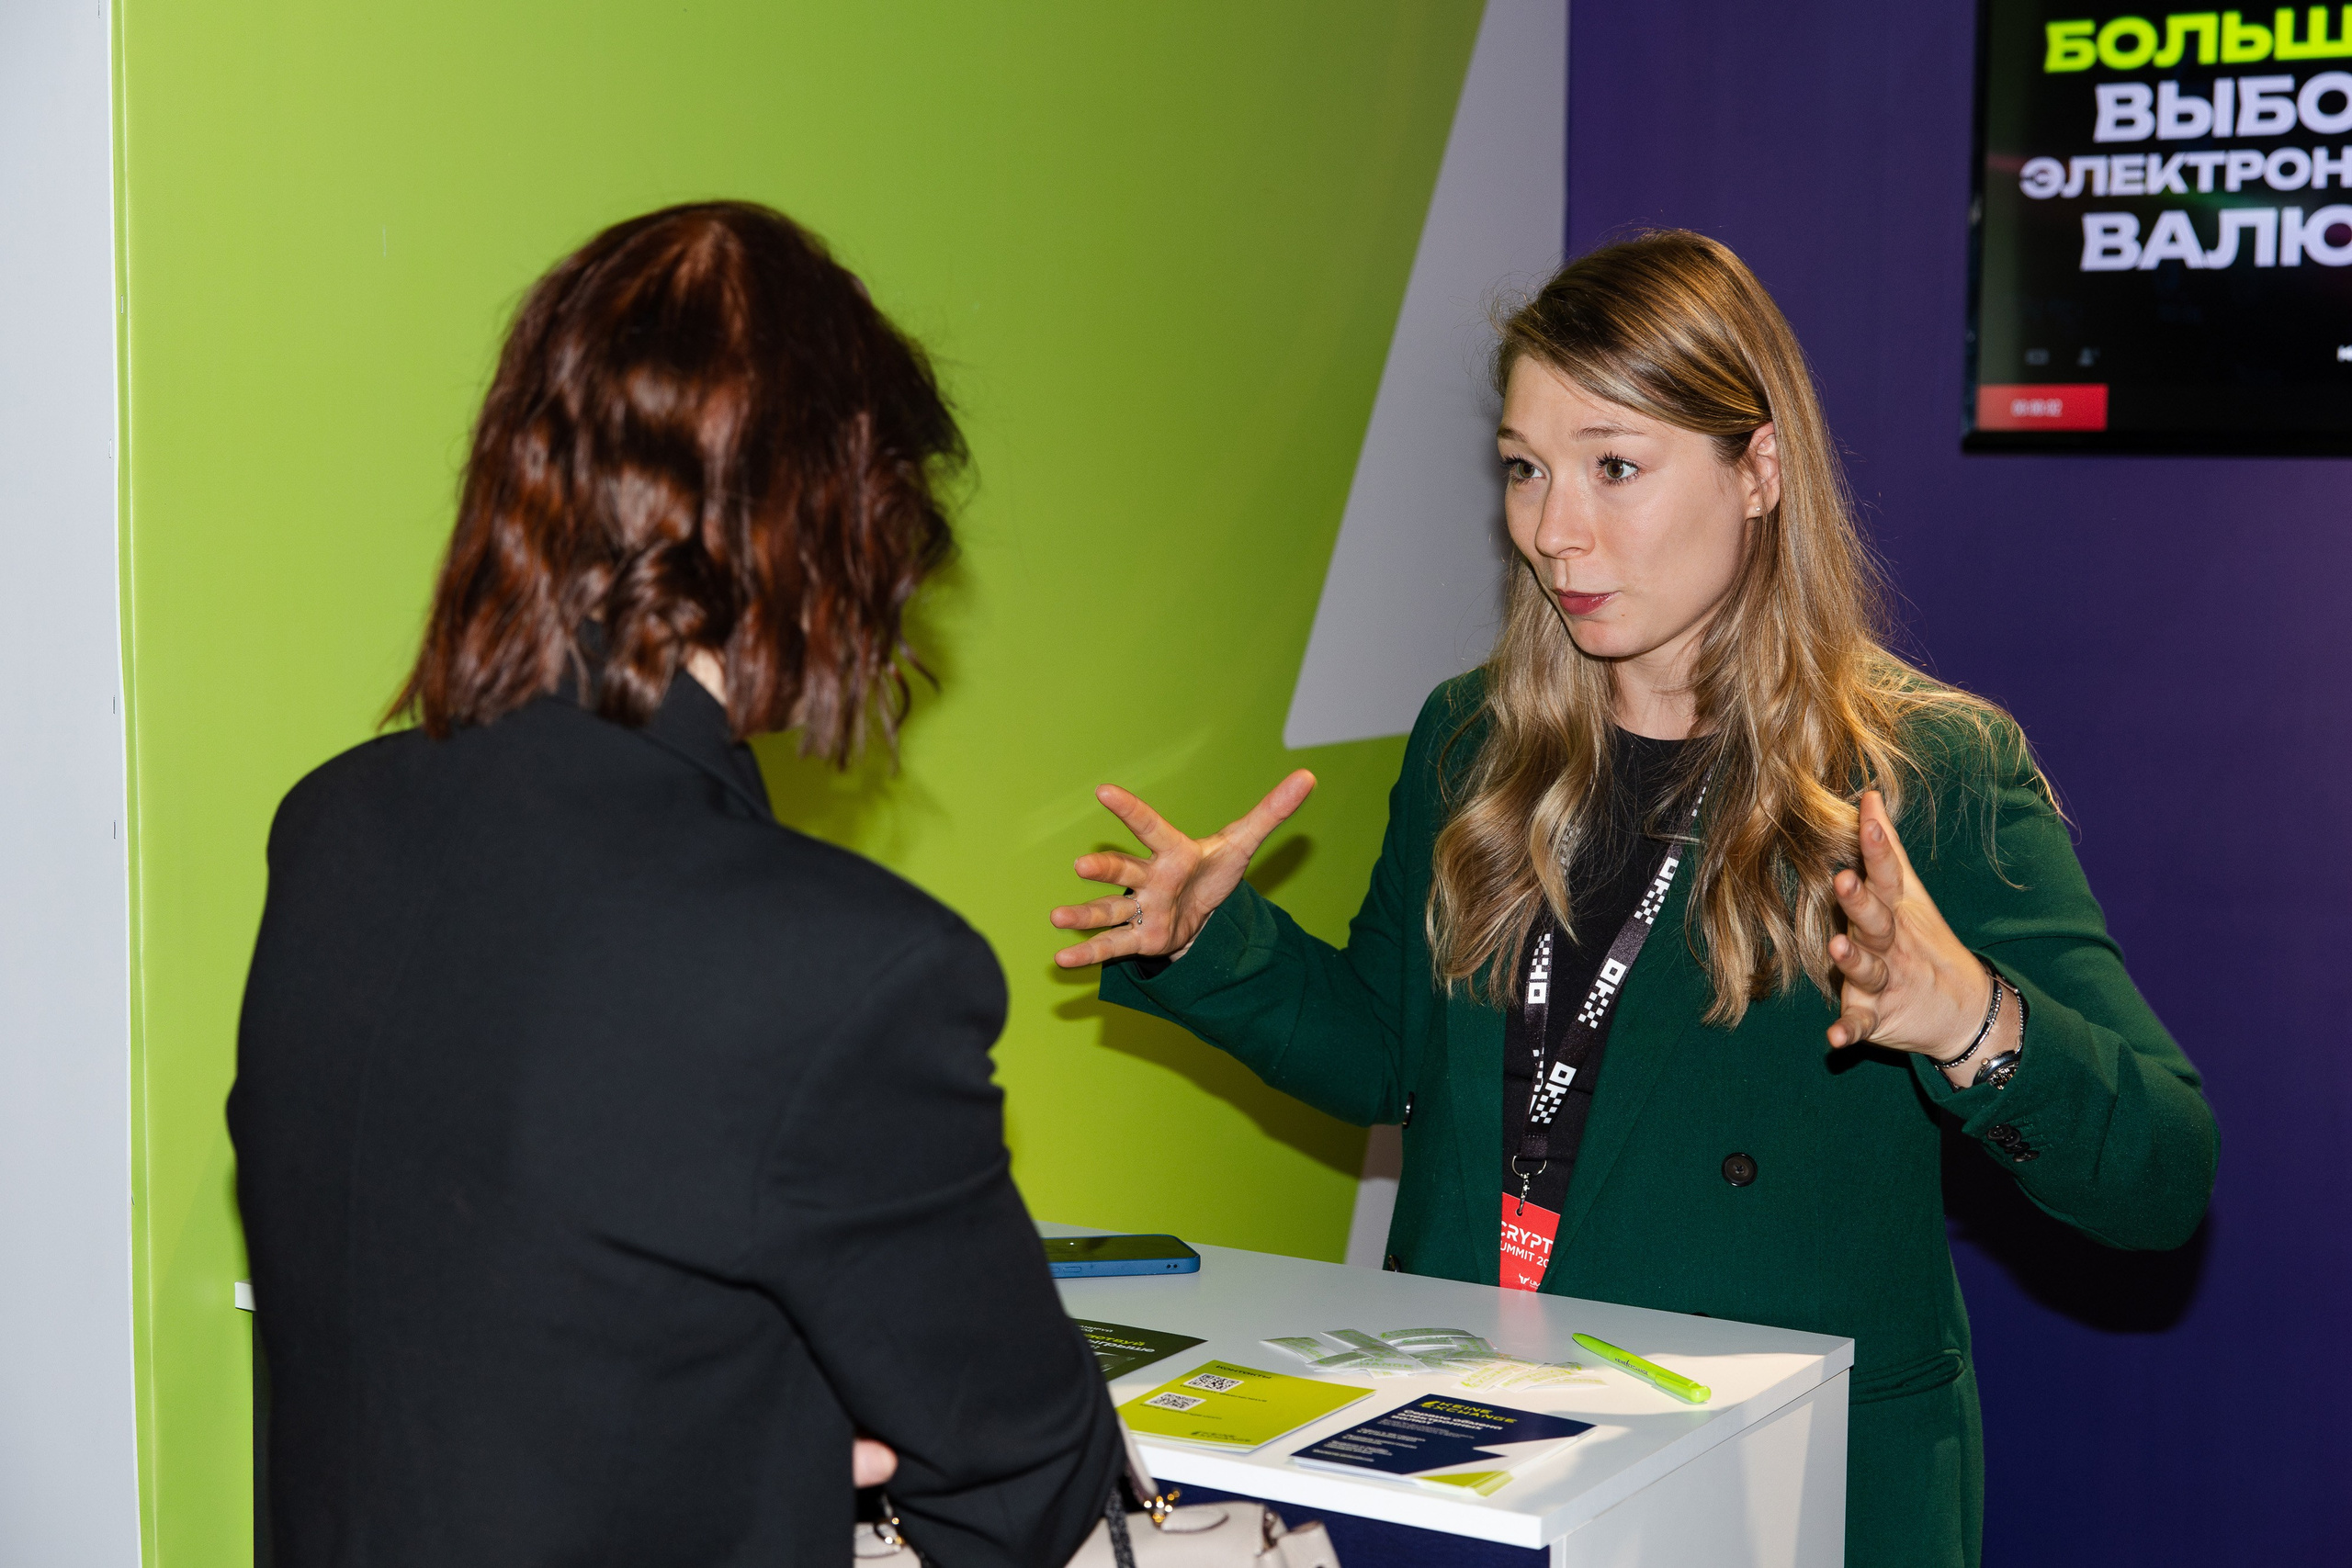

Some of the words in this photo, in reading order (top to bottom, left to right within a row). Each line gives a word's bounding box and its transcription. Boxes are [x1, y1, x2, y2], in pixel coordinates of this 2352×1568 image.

[2092, 71, 2352, 143] ВЫБО
[2018, 145, 2352, 199] ЭЛЕКТРОН
[2080, 204, 2352, 272] ВАЛЮ
[1439, 1402, 1494, 1414] KEINE
